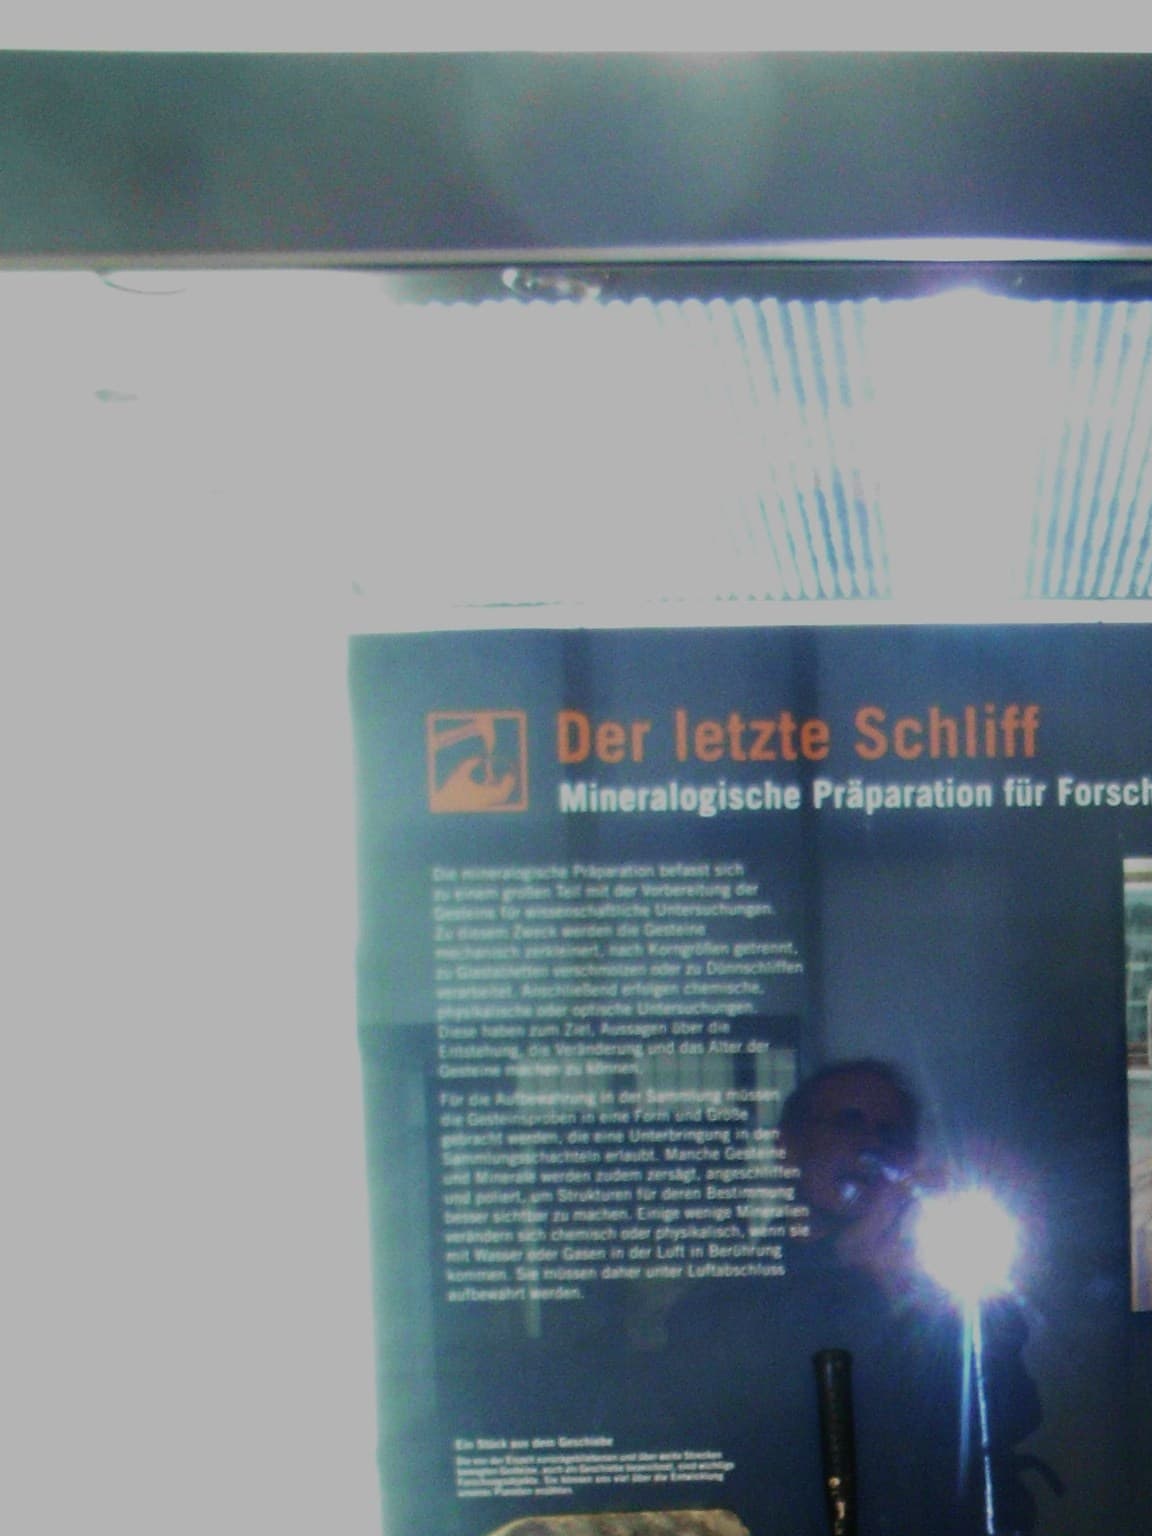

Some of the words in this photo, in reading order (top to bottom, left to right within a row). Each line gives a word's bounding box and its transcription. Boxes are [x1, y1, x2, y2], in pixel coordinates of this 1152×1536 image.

[557, 708, 651, 763] Der
[673, 705, 831, 762] letzte
[853, 703, 1040, 760] Schliff
[558, 779, 802, 817] Mineralogische
[812, 777, 993, 815] Präparation
[1003, 776, 1047, 807] für
